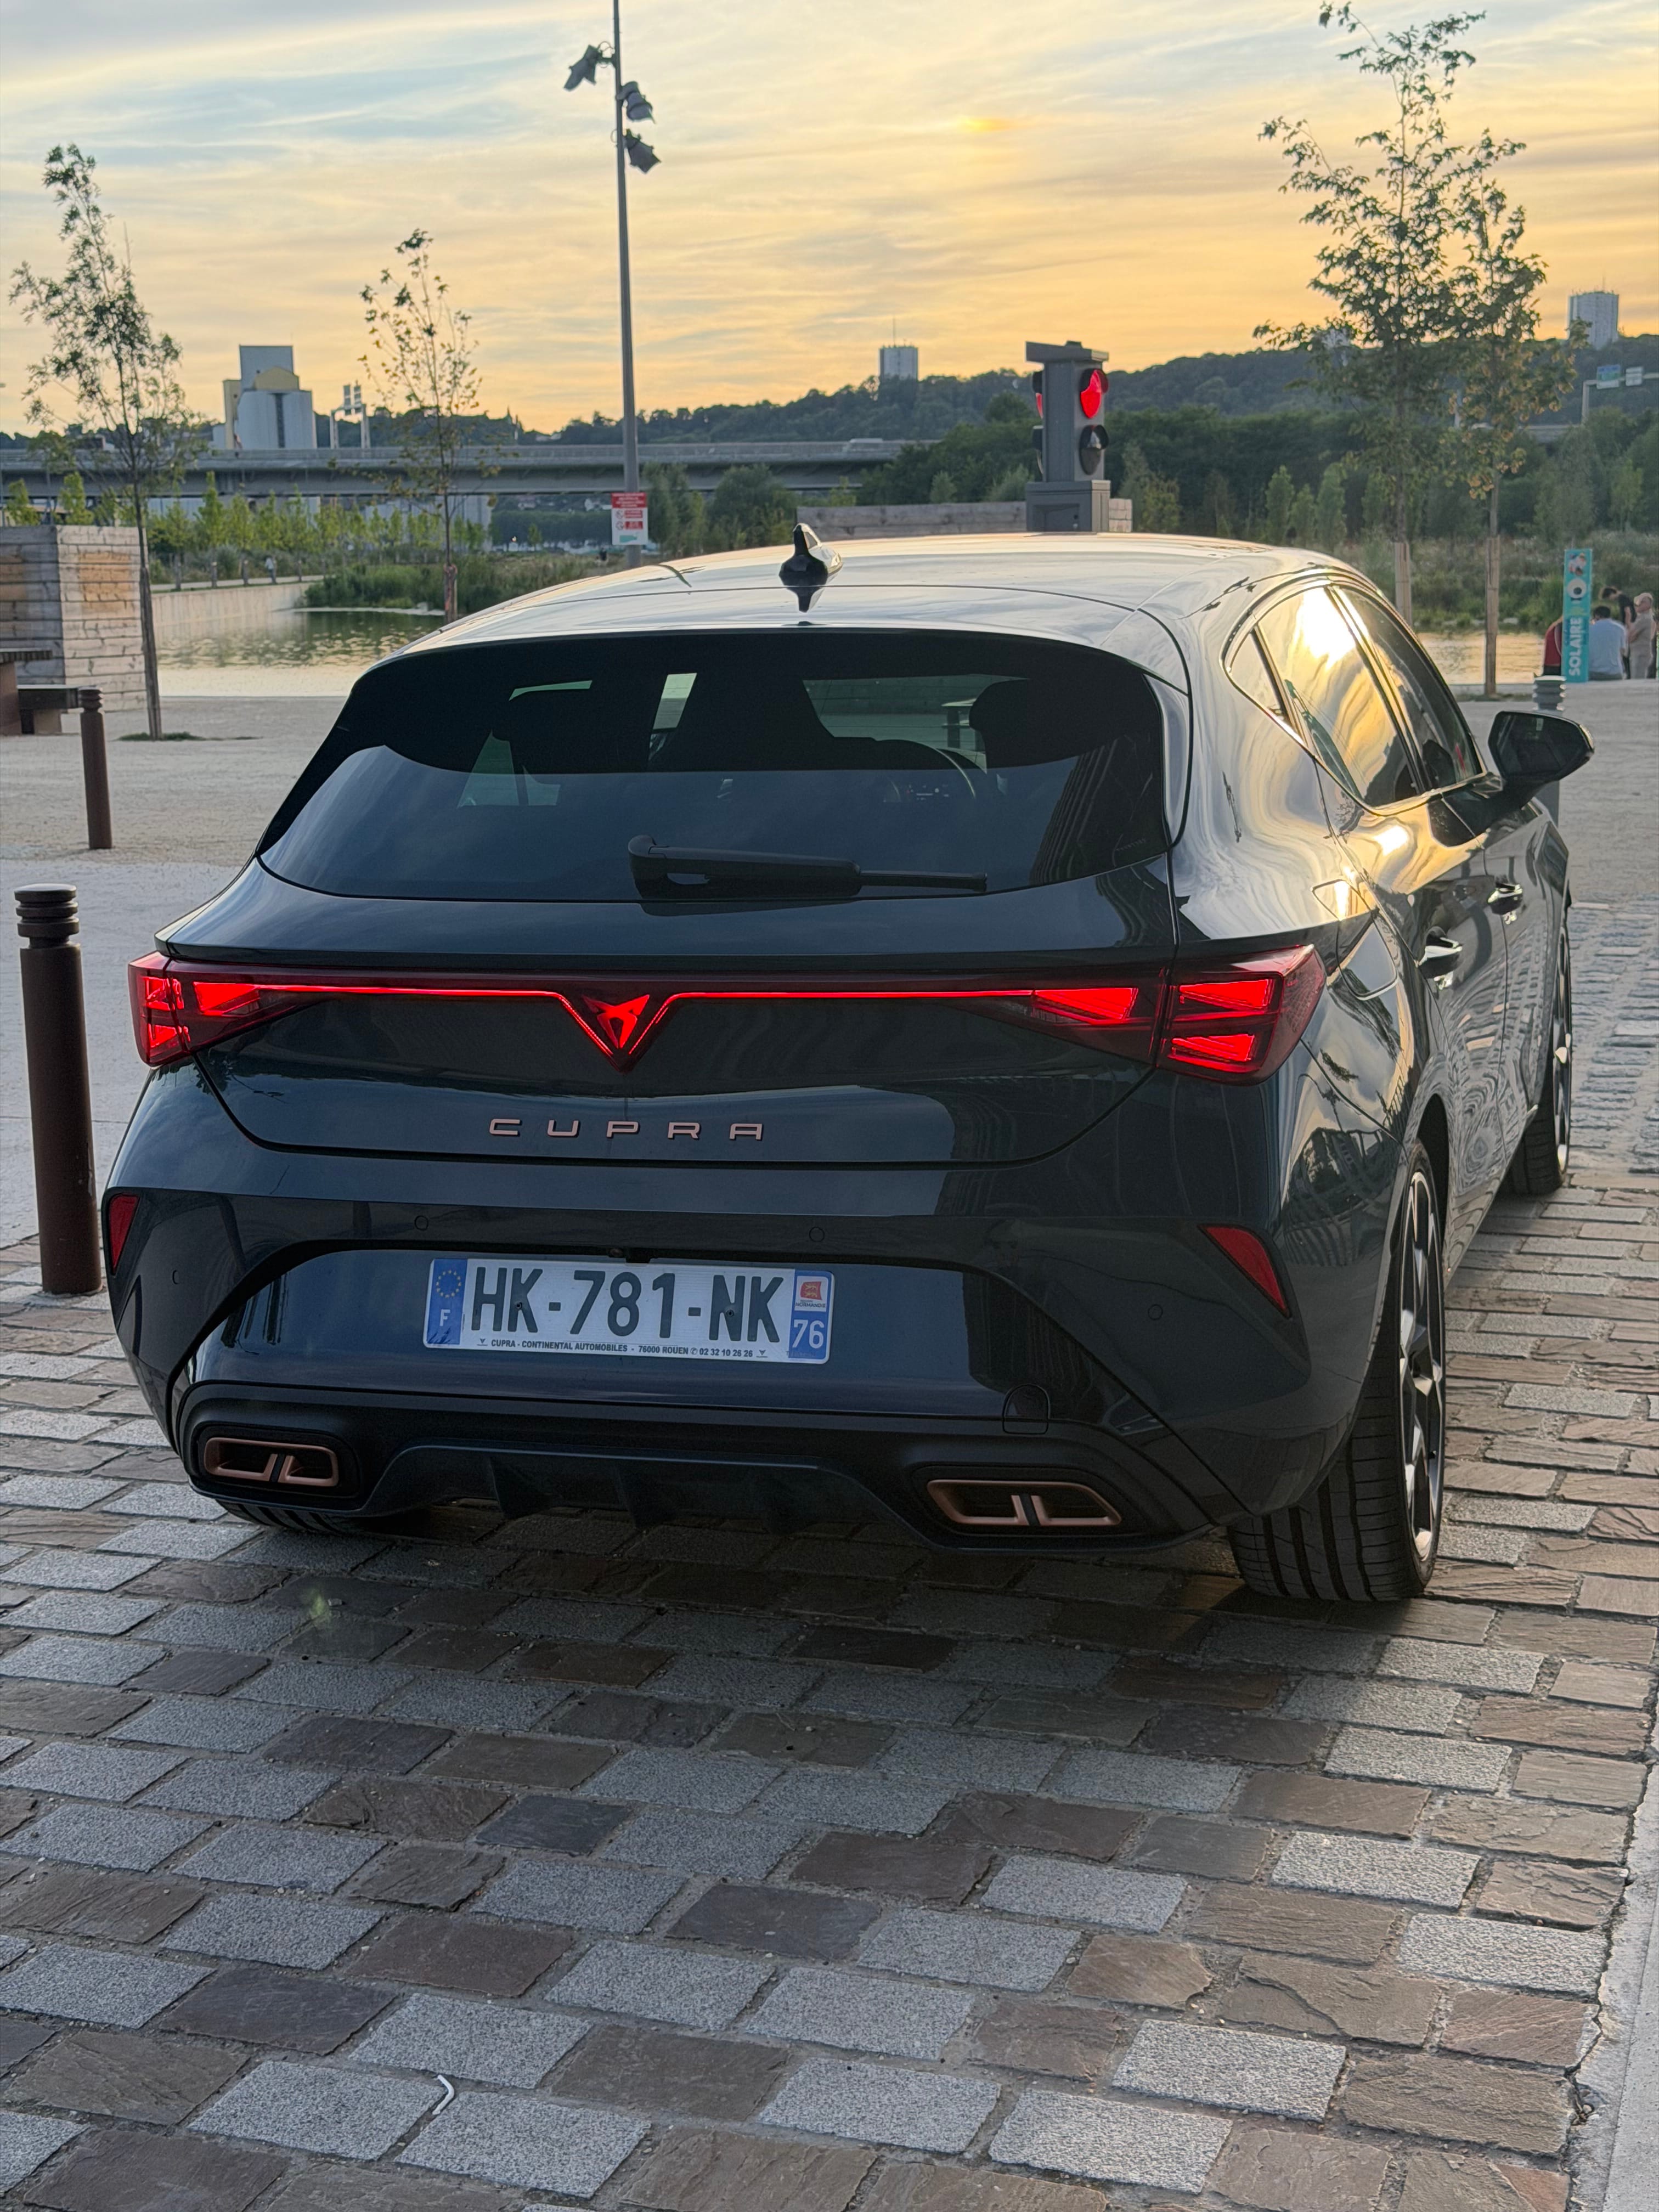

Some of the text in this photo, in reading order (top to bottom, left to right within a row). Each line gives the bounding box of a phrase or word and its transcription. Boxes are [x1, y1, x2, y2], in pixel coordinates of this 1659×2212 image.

[1568, 617, 1582, 676] SOLAIRE
[489, 1119, 763, 1141] CUPRA
[439, 1309, 450, 1326] F
[471, 1267, 784, 1343] HK-781-NK
[792, 1319, 825, 1349] 76
[491, 1339, 516, 1347] CUPRA
[522, 1340, 573, 1350] CONTINENTAL
[574, 1343, 628, 1352] AUTOMOBILES
[638, 1345, 659, 1353] 76000
[662, 1346, 688, 1355] ROUEN
[710, 1348, 720, 1356] 32
